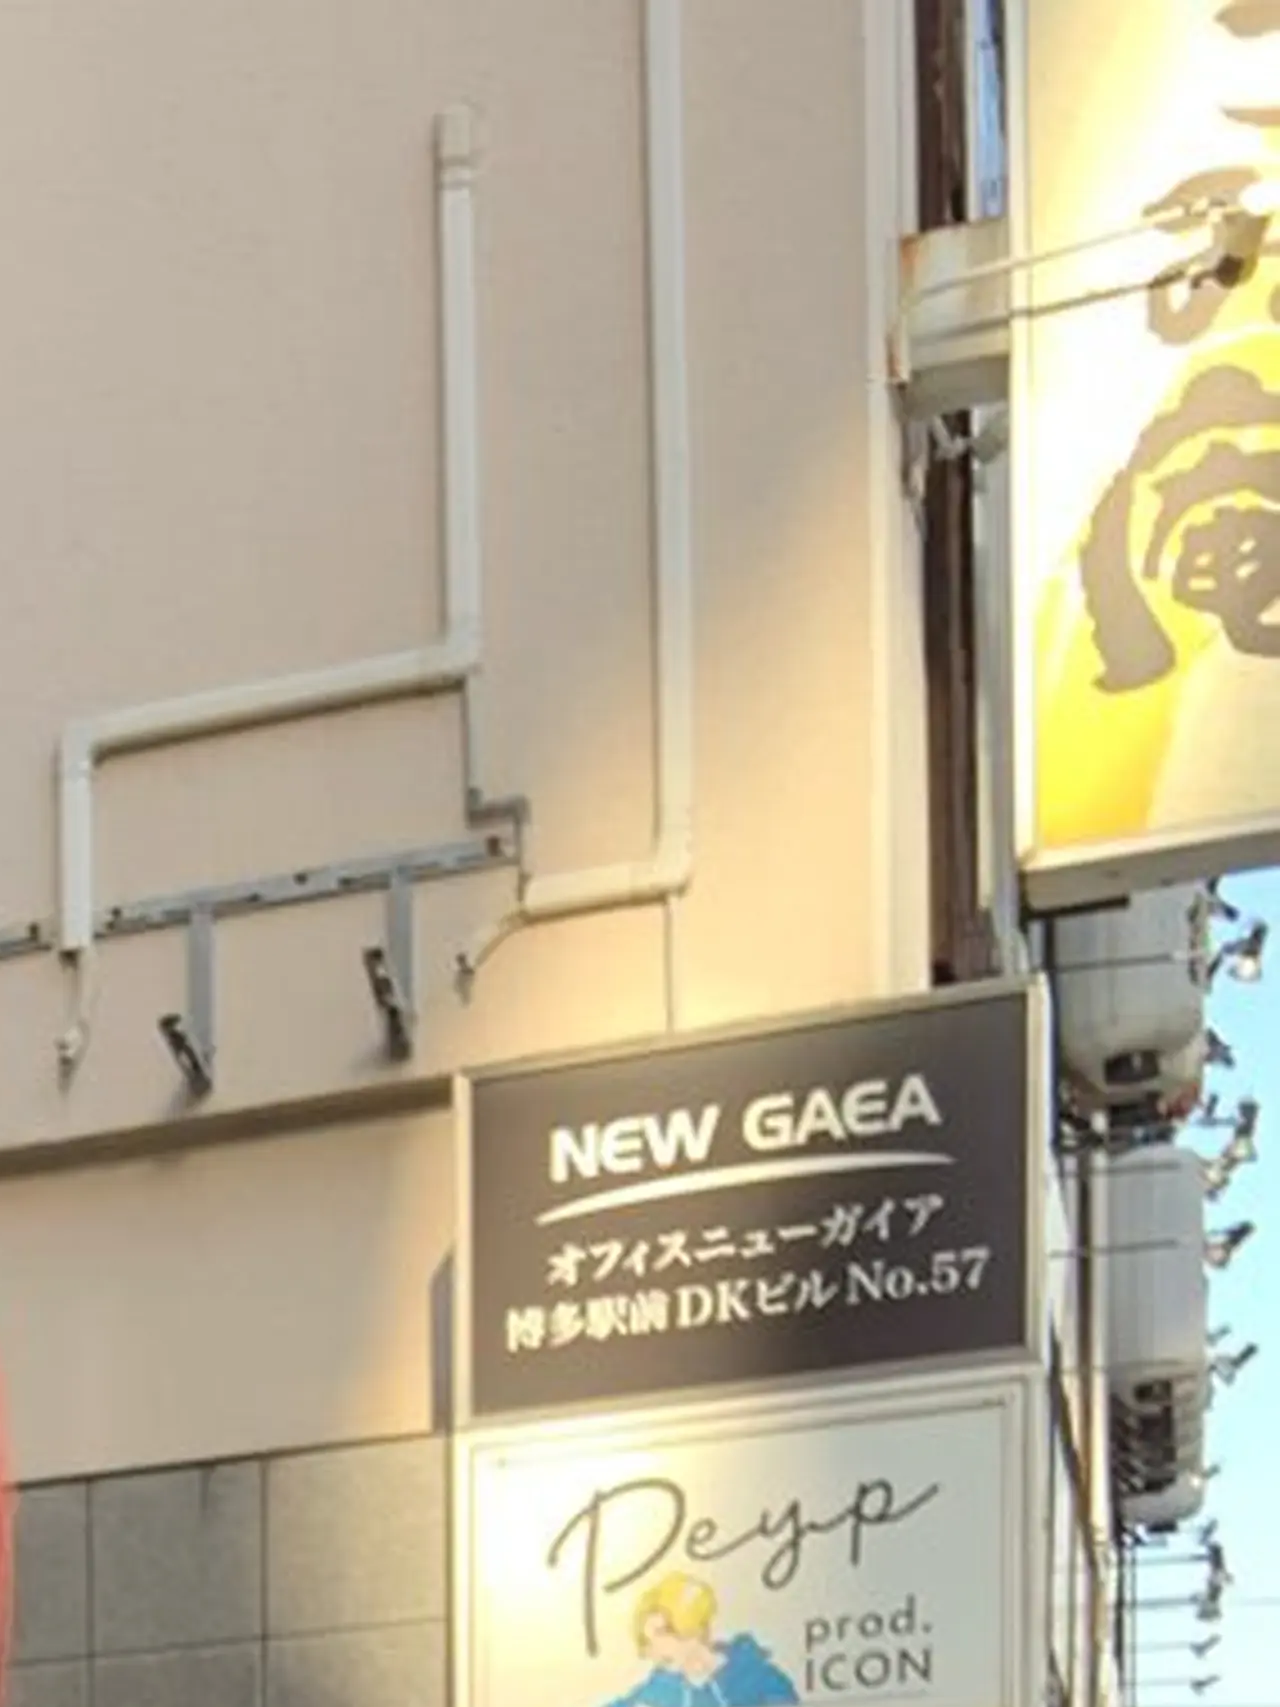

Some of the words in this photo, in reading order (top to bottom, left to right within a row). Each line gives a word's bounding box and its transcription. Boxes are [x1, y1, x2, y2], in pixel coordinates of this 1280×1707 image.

[549, 1104, 721, 1183] NEW
[742, 1073, 942, 1152] GAEA
[545, 1194, 944, 1287] オフィスニューガイア
[547, 1476, 940, 1659] Peyp
[804, 1592, 934, 1653] prod.
[805, 1648, 932, 1692] ICON
